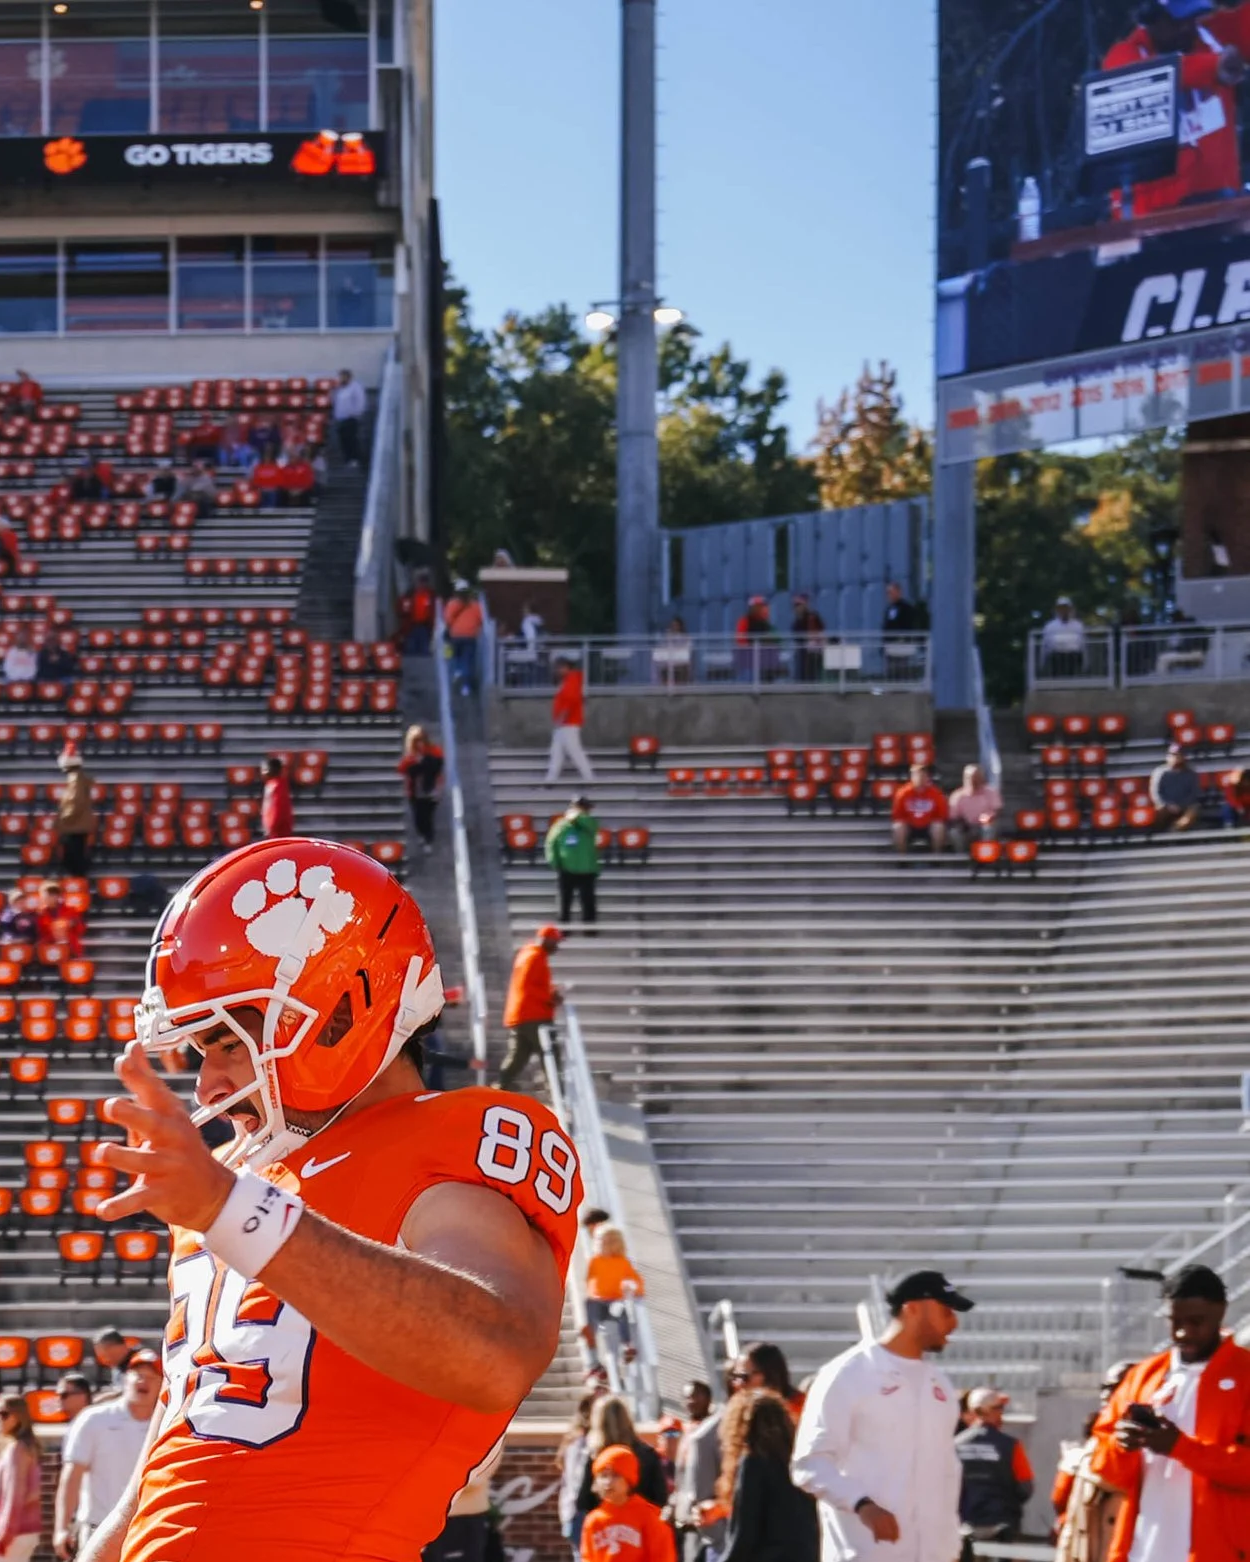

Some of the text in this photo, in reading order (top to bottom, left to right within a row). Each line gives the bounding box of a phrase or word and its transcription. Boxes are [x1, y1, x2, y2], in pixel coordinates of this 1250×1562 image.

[124, 142, 273, 166] GO TIGERS
[475, 1104, 578, 1216] 89
